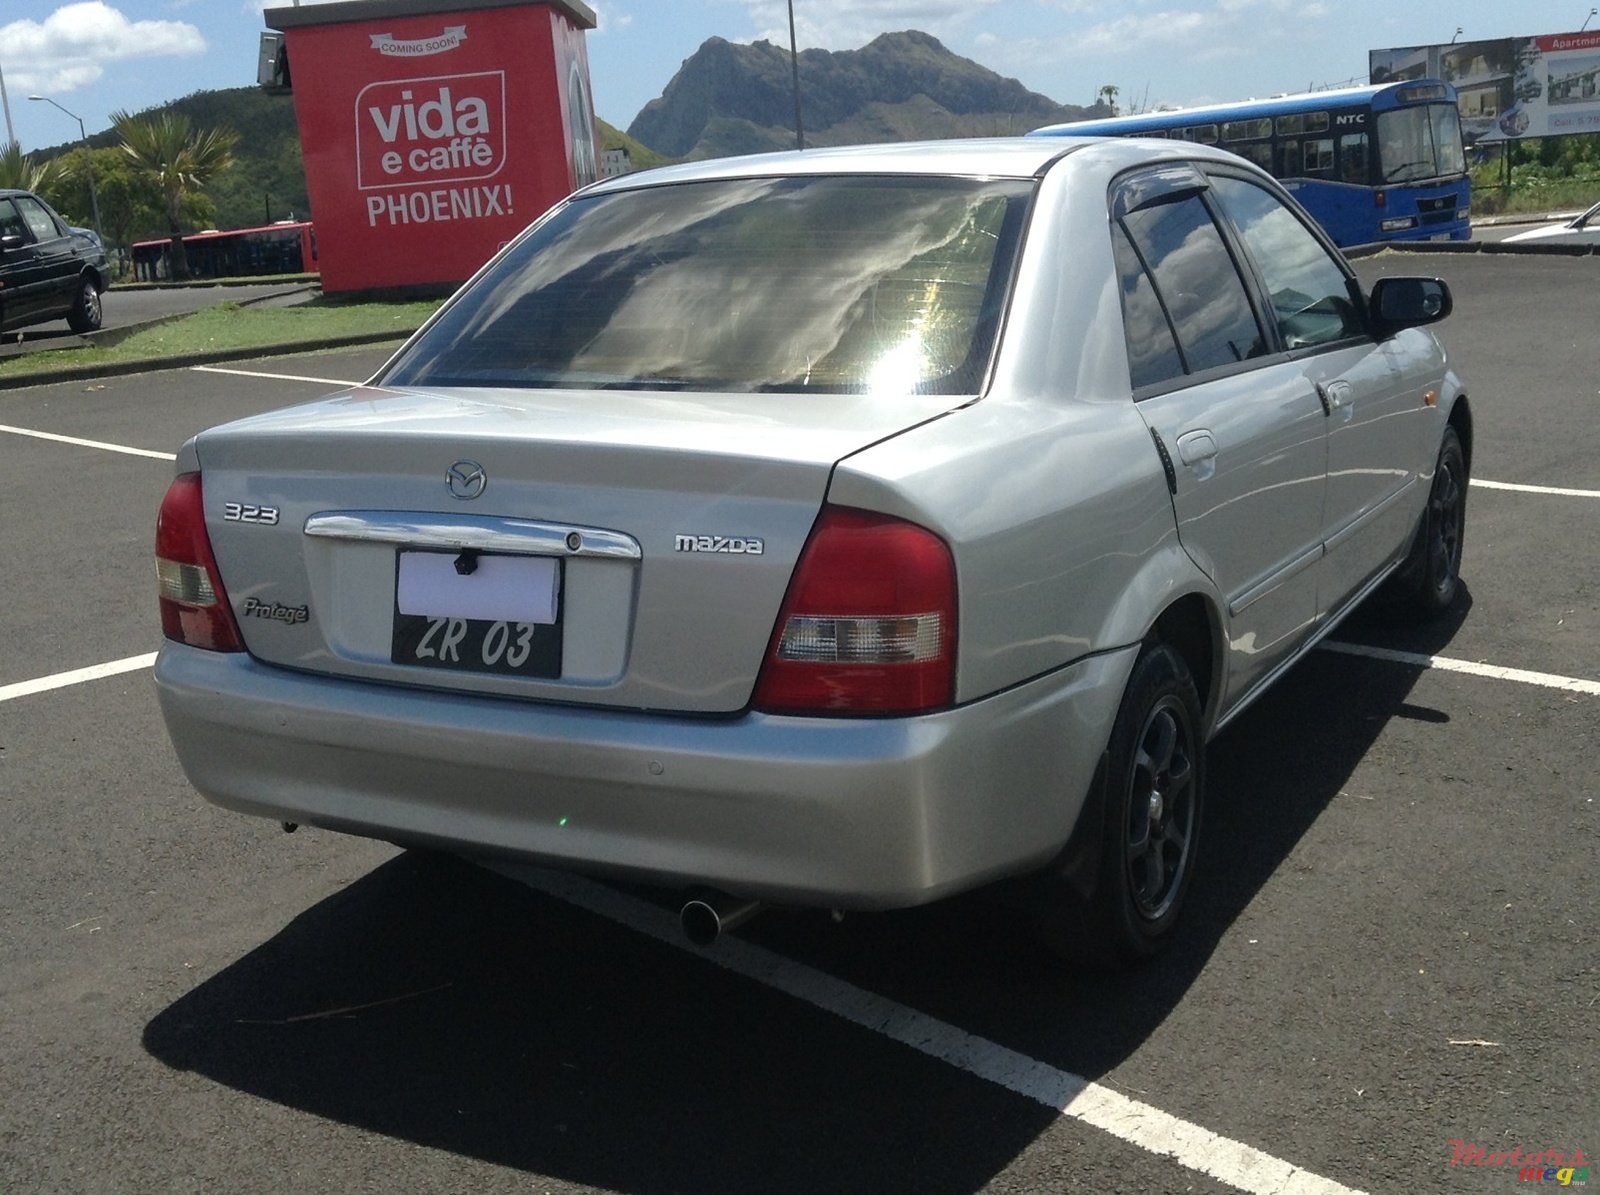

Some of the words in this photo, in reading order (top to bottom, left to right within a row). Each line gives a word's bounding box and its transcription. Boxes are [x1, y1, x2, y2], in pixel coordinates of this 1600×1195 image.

[381, 43, 423, 53] COMING
[425, 35, 457, 51] SOON!
[368, 87, 490, 143] vida
[1336, 113, 1365, 125] NTC
[381, 151, 402, 174] e
[409, 137, 493, 172] caffè
[366, 184, 514, 227] PHOENIX!
[223, 502, 279, 525] 323
[415, 616, 467, 663] ZR
[482, 621, 535, 668] 03
